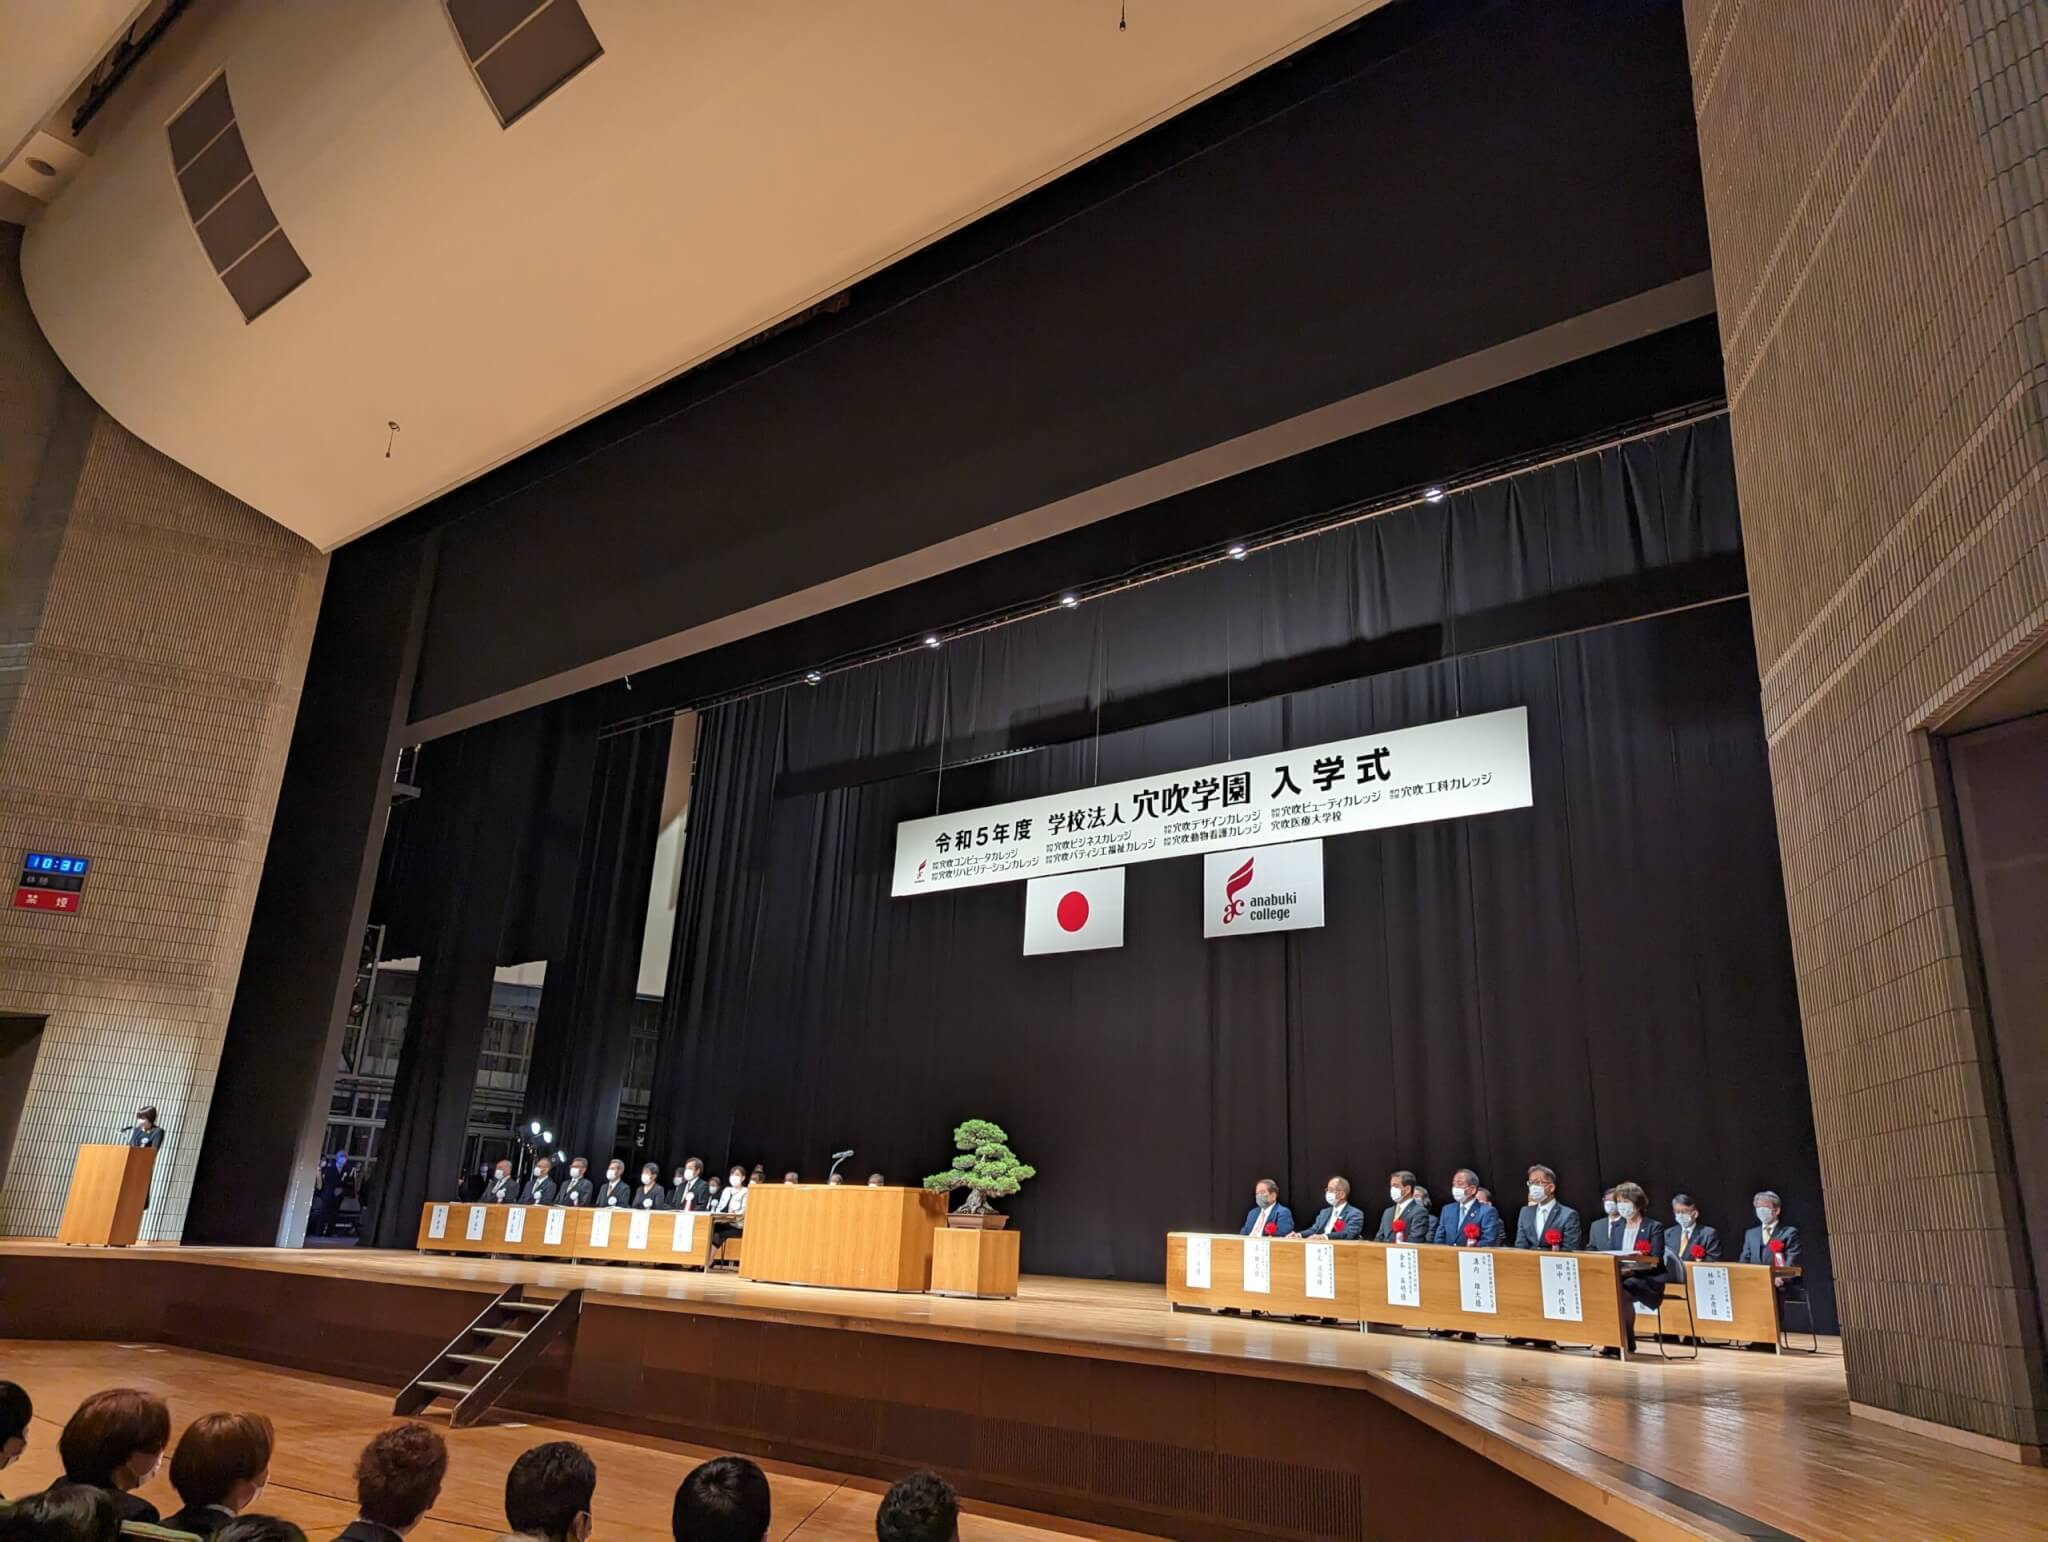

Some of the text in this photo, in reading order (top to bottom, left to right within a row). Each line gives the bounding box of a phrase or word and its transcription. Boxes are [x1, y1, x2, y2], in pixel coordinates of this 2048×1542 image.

[935, 819, 1033, 854] 令和5年度
[1271, 747, 1391, 799] 入学式
[33, 857, 85, 872] 10:30
[1250, 892, 1297, 907] anabuki
[1250, 908, 1290, 921] college
